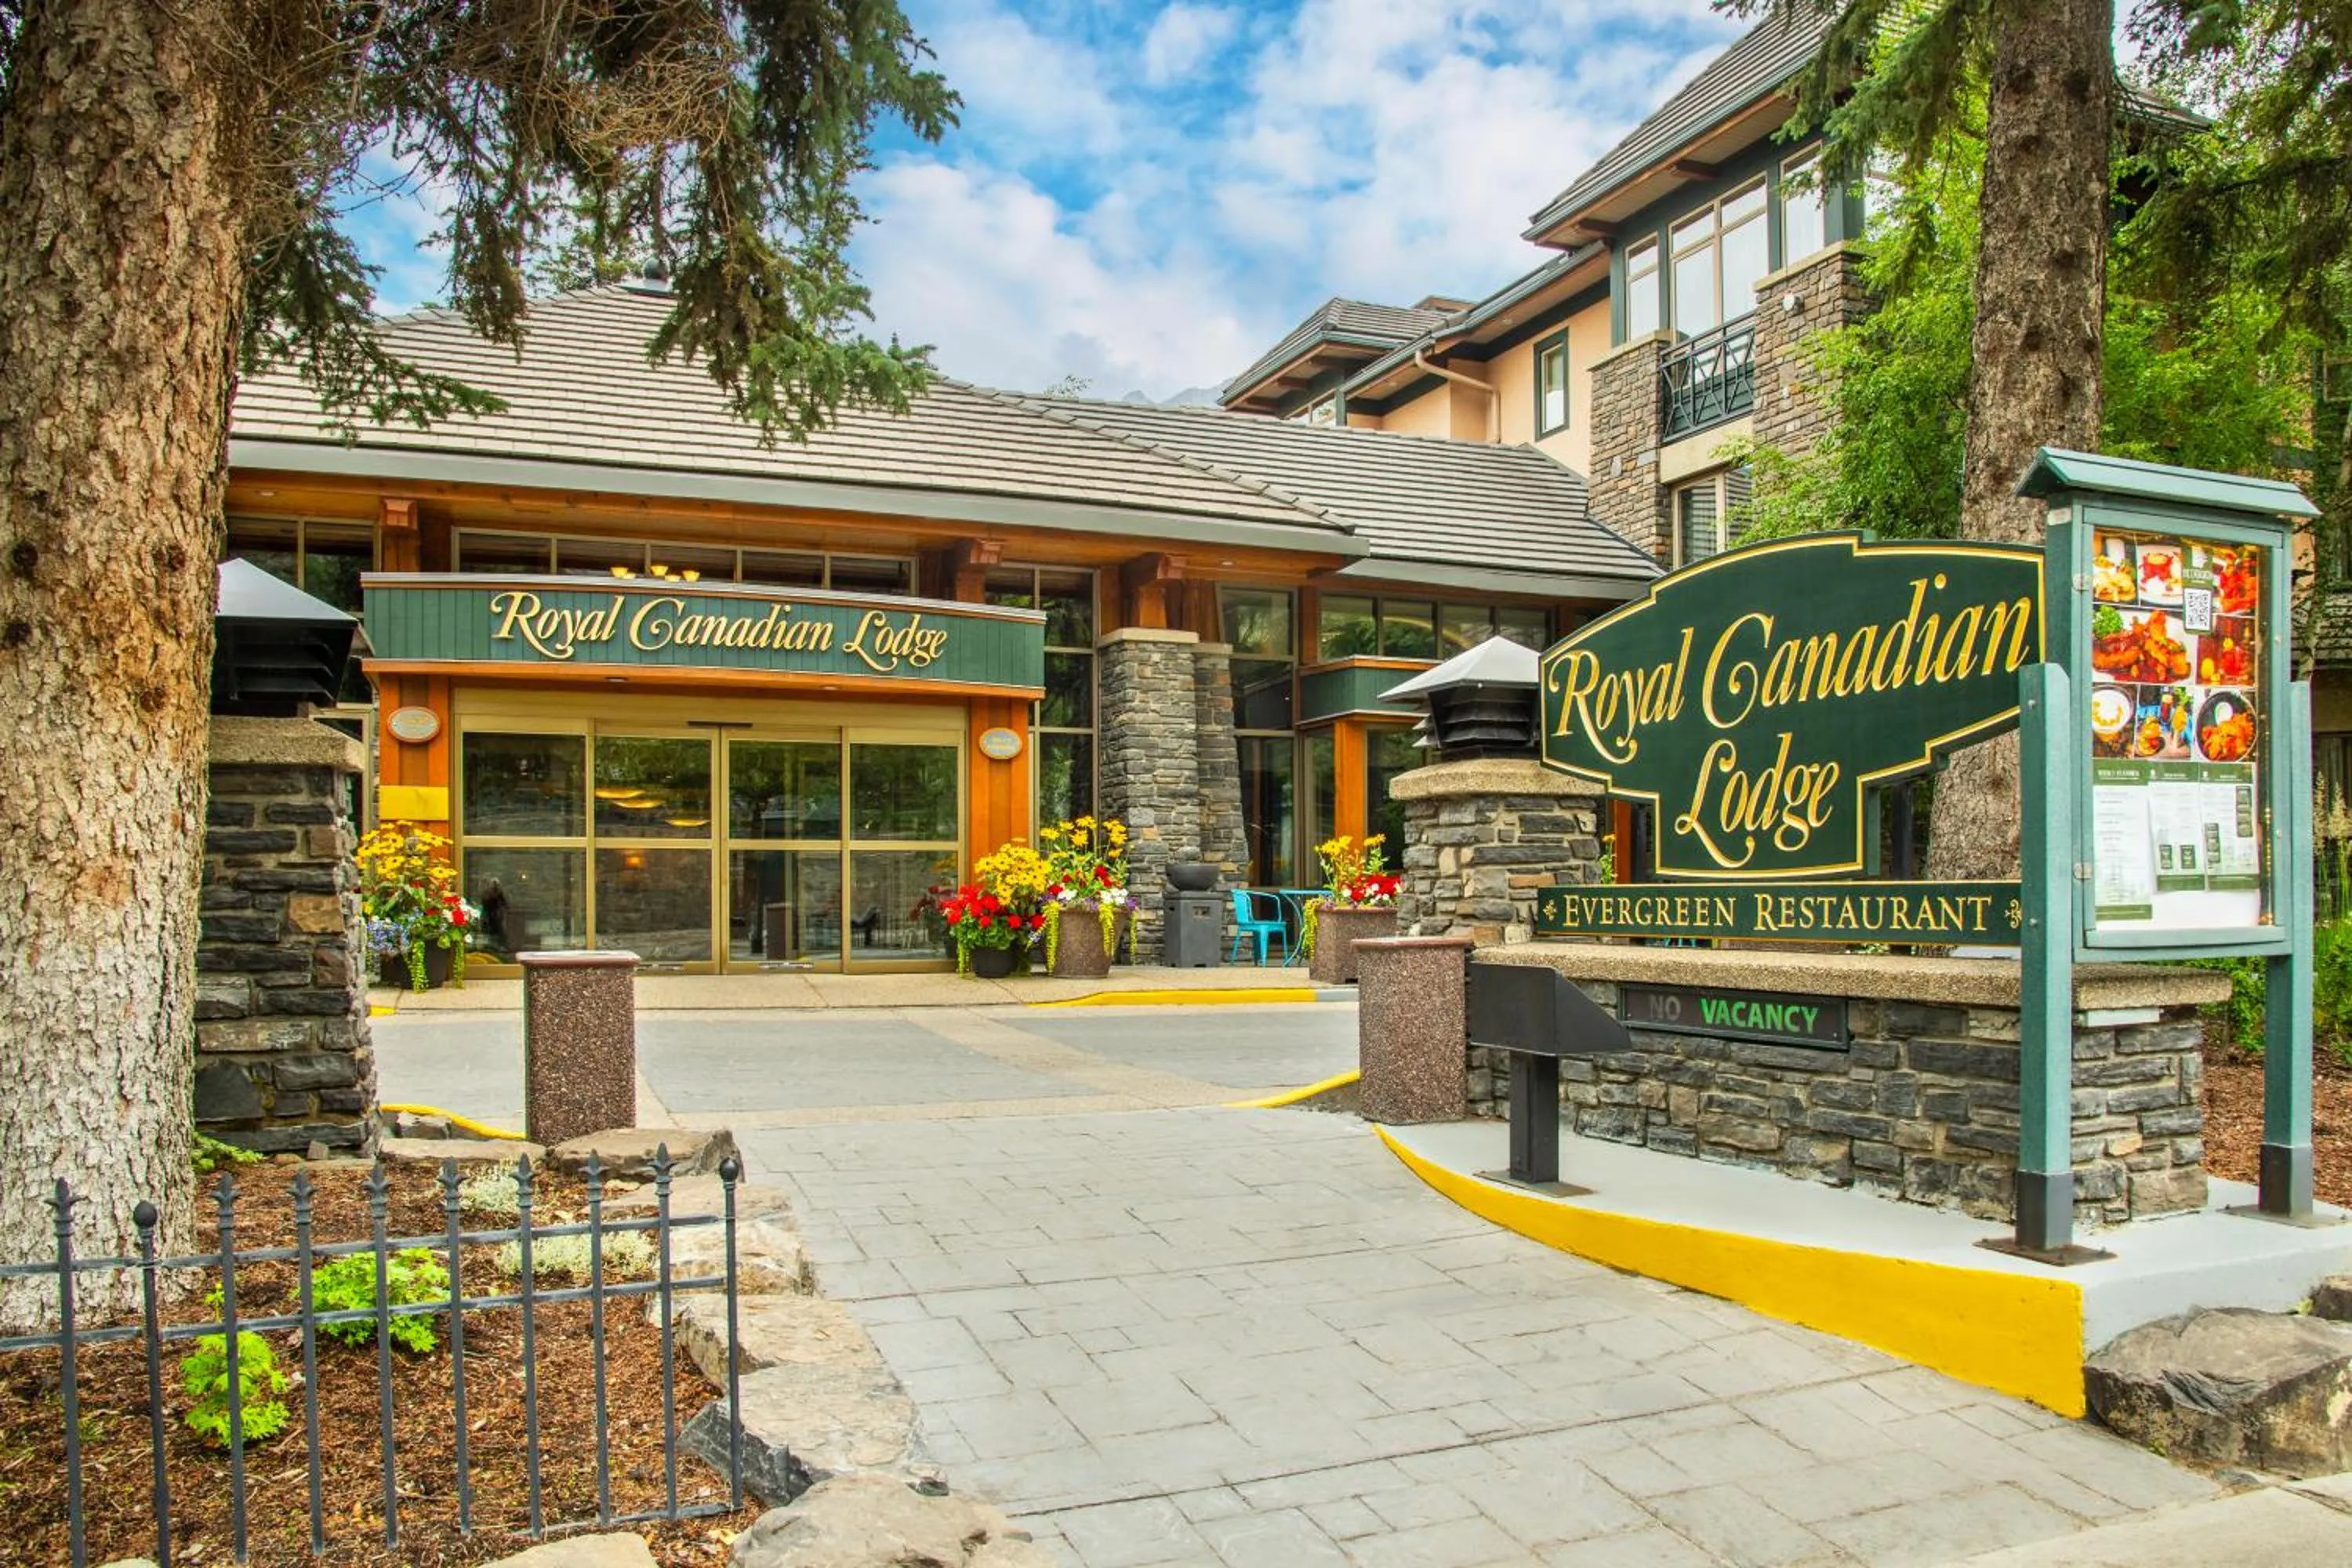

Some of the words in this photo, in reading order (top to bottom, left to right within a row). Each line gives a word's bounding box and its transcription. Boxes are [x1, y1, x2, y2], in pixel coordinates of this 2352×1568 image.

[491, 592, 624, 659] Royal
[630, 597, 833, 651] Canadian
[843, 610, 948, 671] Lodge
[1548, 626, 1693, 764] Royal
[1702, 573, 2032, 729] Canadian
[1675, 732, 1840, 868] Lodge
[1563, 895, 1736, 928] EVERGREEN
[1754, 892, 1992, 931] RESTAURANT
[1650, 993, 1681, 1019] NO
[1700, 1000, 1820, 1033] VACANCY
